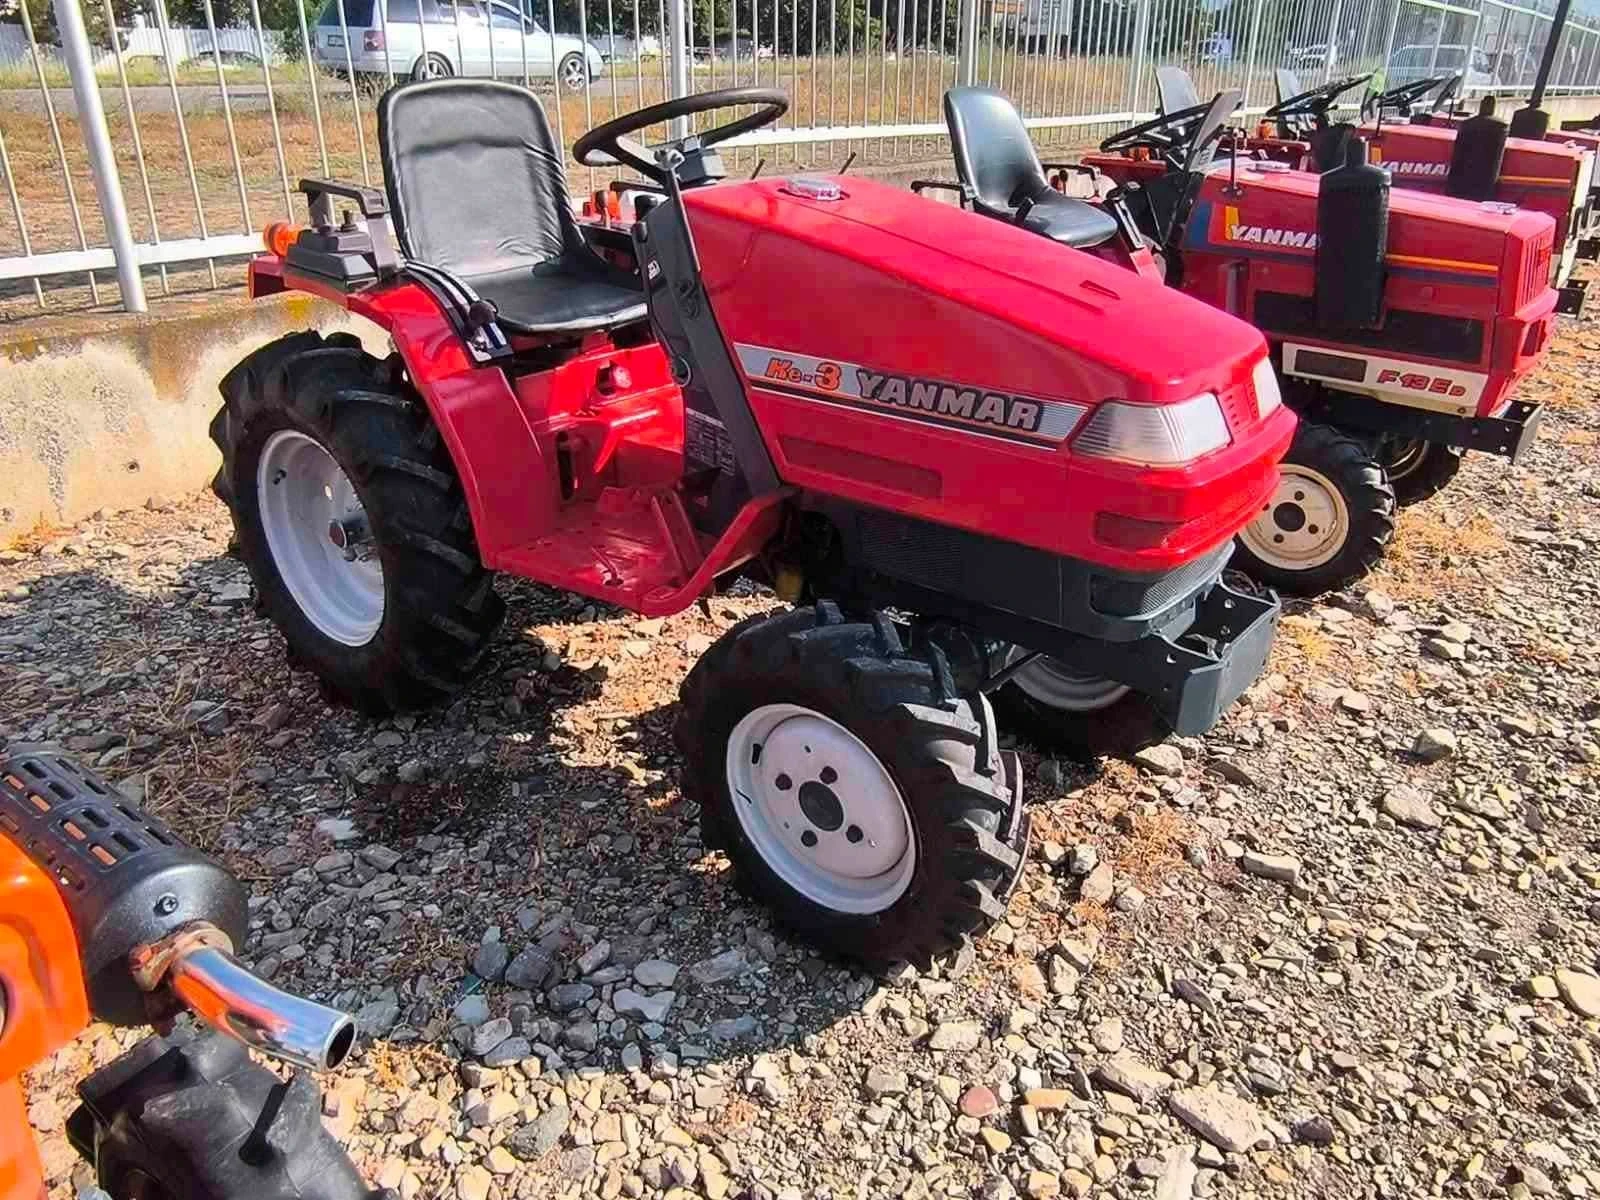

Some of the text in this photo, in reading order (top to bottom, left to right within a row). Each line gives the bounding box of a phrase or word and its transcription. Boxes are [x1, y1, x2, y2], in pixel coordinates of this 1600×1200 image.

[1376, 160, 1451, 176] YANMA
[1230, 224, 1320, 249] YANMA
[765, 356, 1043, 431] Ke-3 YANMAR
